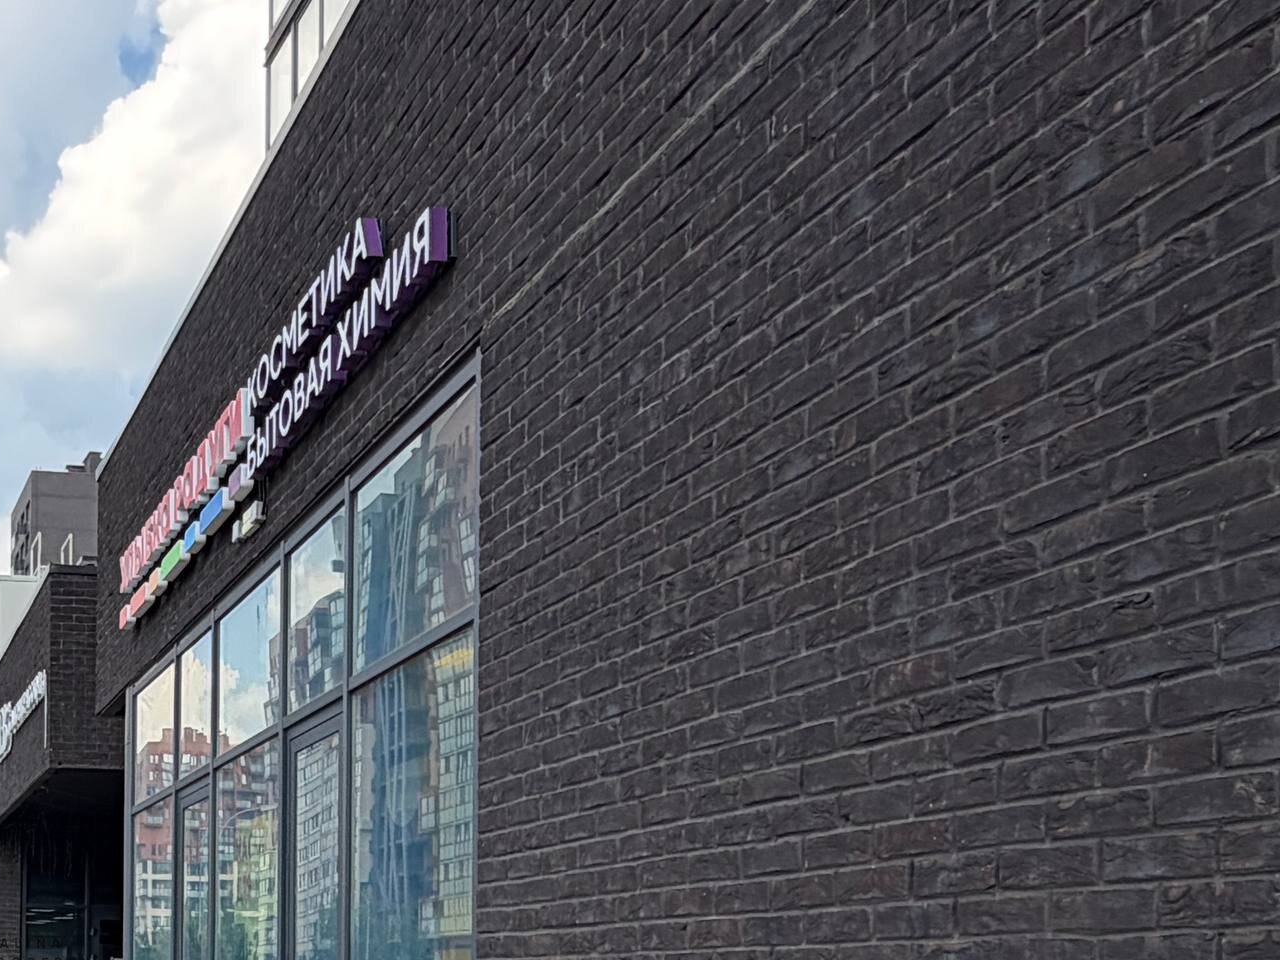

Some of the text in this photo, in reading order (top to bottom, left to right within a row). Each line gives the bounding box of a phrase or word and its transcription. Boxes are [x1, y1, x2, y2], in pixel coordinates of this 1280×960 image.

[245, 206, 430, 480] БЫТОВАЯ ХИМИЯ
[247, 217, 368, 411] КОСМЕТИКА
